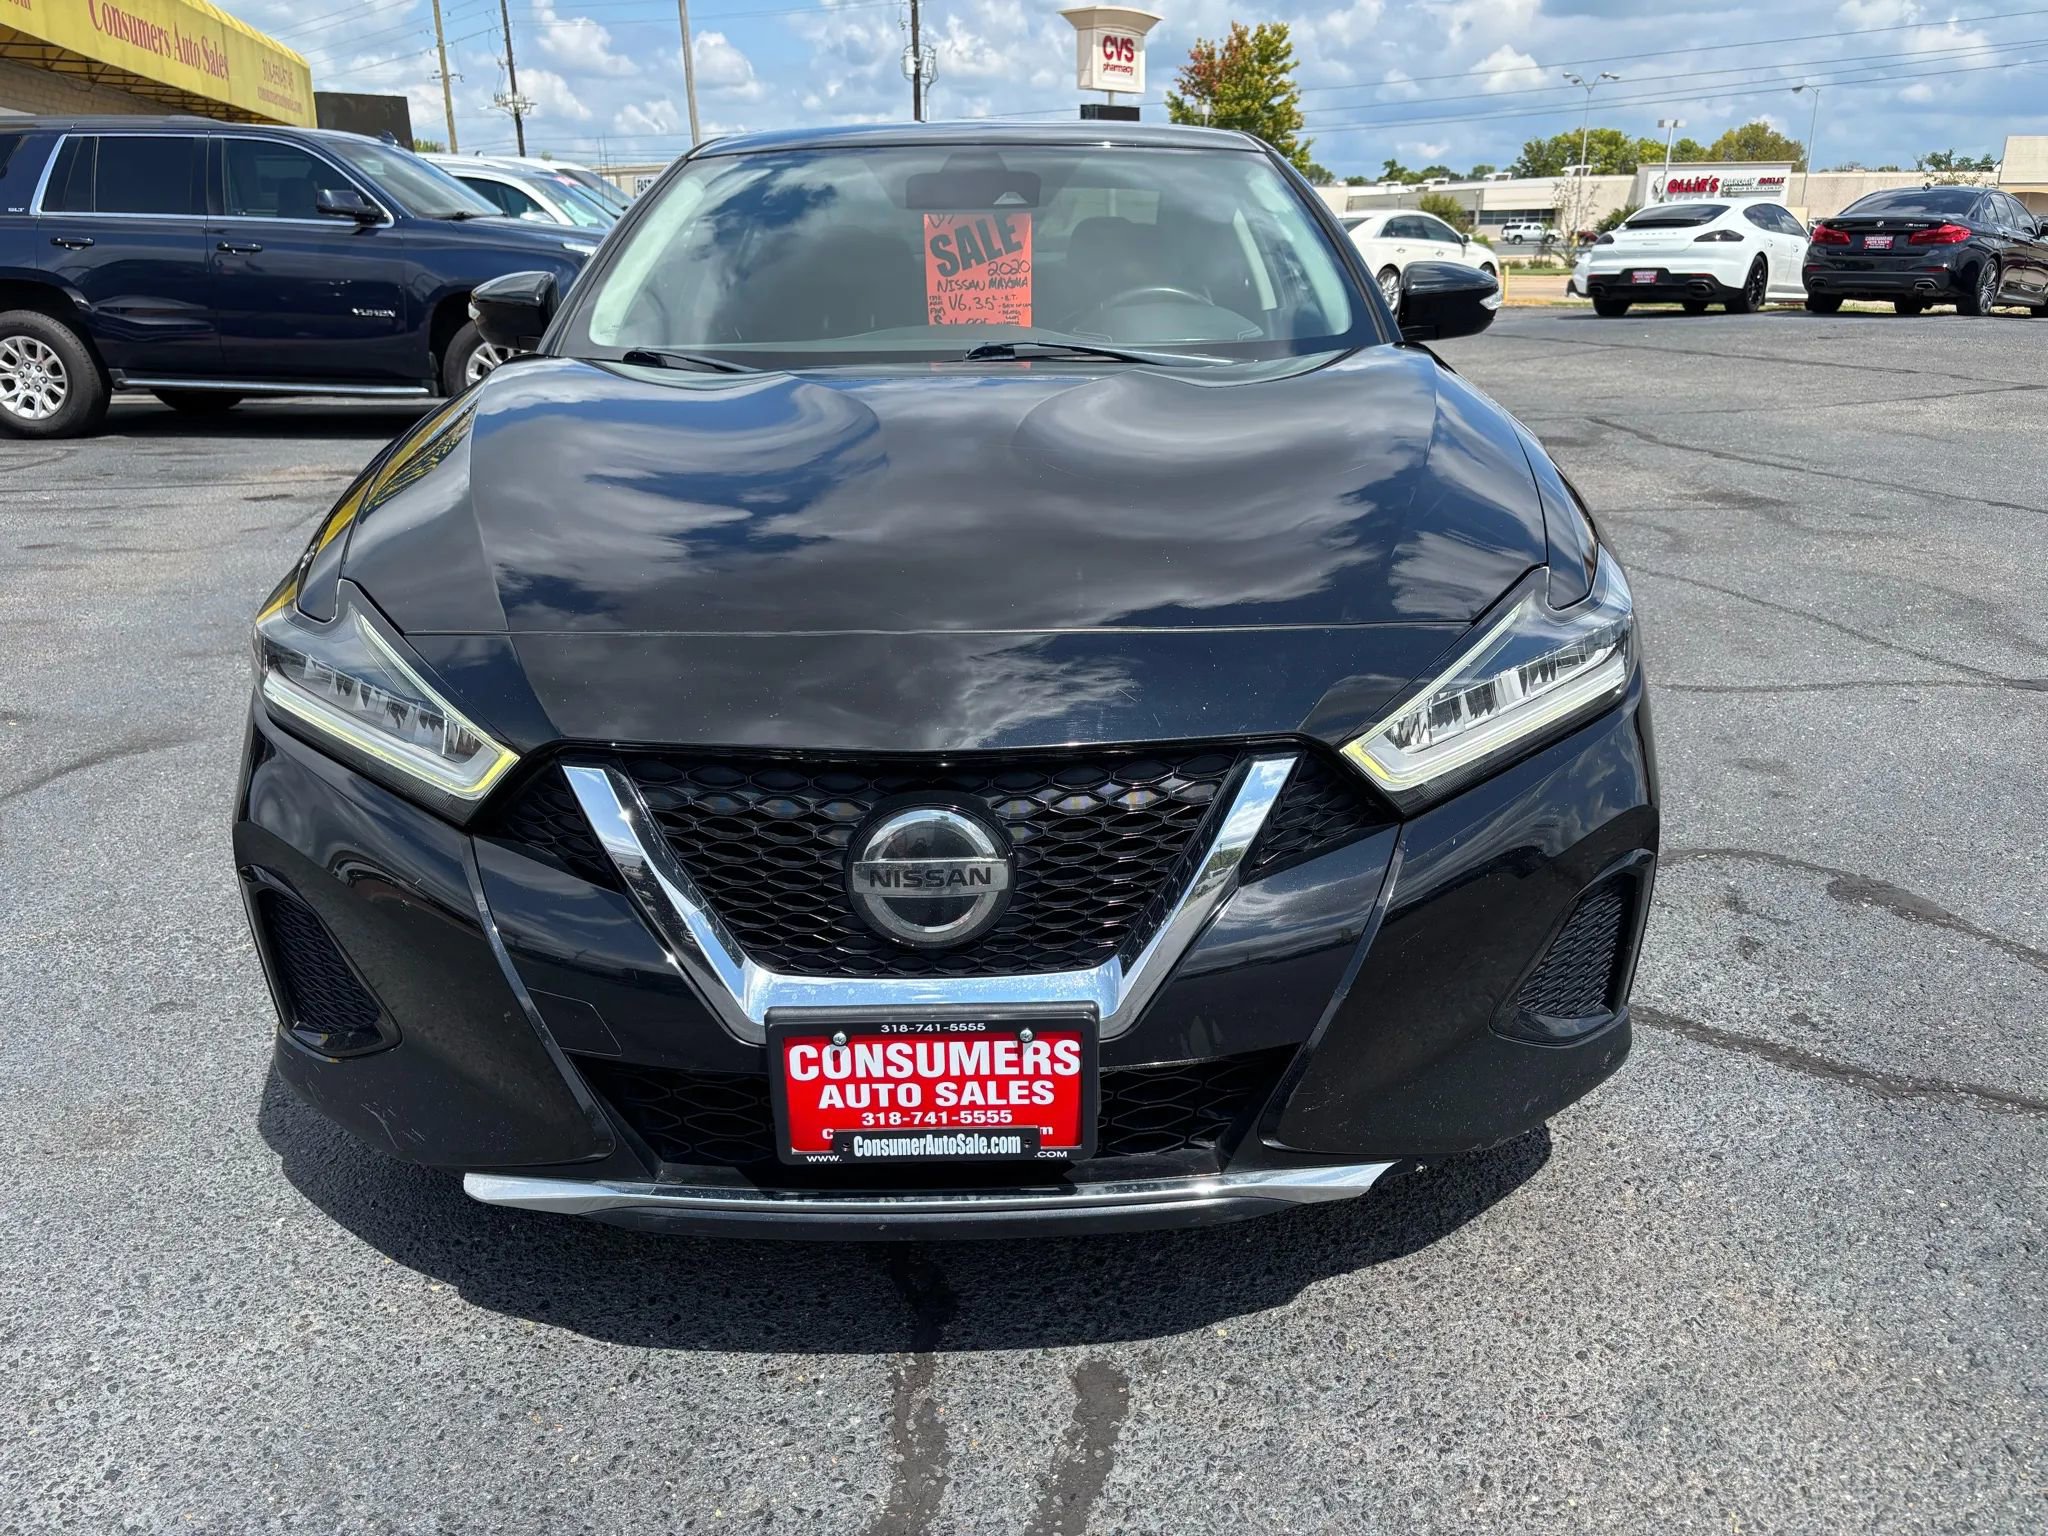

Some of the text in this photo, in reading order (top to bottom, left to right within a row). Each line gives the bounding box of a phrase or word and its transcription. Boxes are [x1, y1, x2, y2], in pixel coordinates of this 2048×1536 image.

[174, 21, 200, 70] Auto
[201, 35, 230, 80] Sales
[1103, 35, 1134, 63] CVS
[1103, 62, 1134, 76] pharmacy
[930, 210, 1023, 277] SALE
[987, 259, 1030, 276] 2020
[937, 279, 985, 293] NISSAN
[870, 867, 991, 888] NISSAN
[880, 1022, 986, 1033] 318-741-5555
[789, 1039, 1081, 1081] CONSUMERS
[818, 1080, 1055, 1109] AUTO SALES
[861, 1109, 1013, 1126] 318-741-5555
[853, 1133, 1021, 1157] ConsumerAutoSale.com
